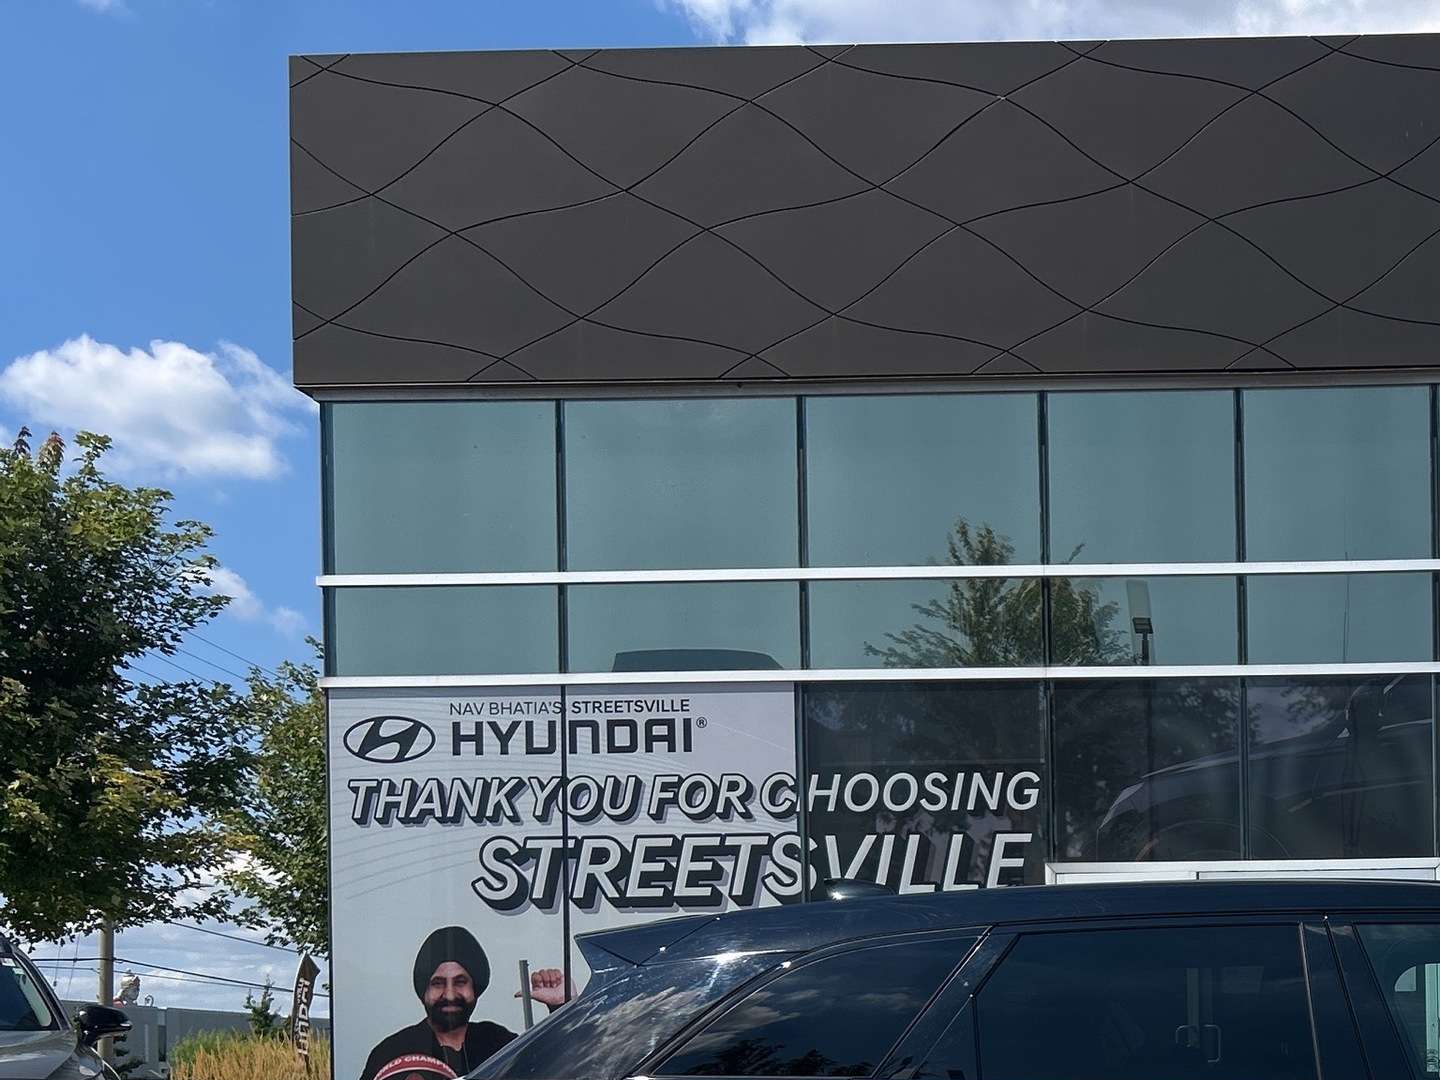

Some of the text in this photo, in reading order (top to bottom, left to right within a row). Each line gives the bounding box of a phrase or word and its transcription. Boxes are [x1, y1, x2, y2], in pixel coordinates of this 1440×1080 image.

[450, 699, 690, 715] NAV BHATIA'S STREETSVILLE
[348, 771, 1041, 825] THANK YOU FOR CHOOSING
[472, 832, 1033, 908] STREETSVILLE
